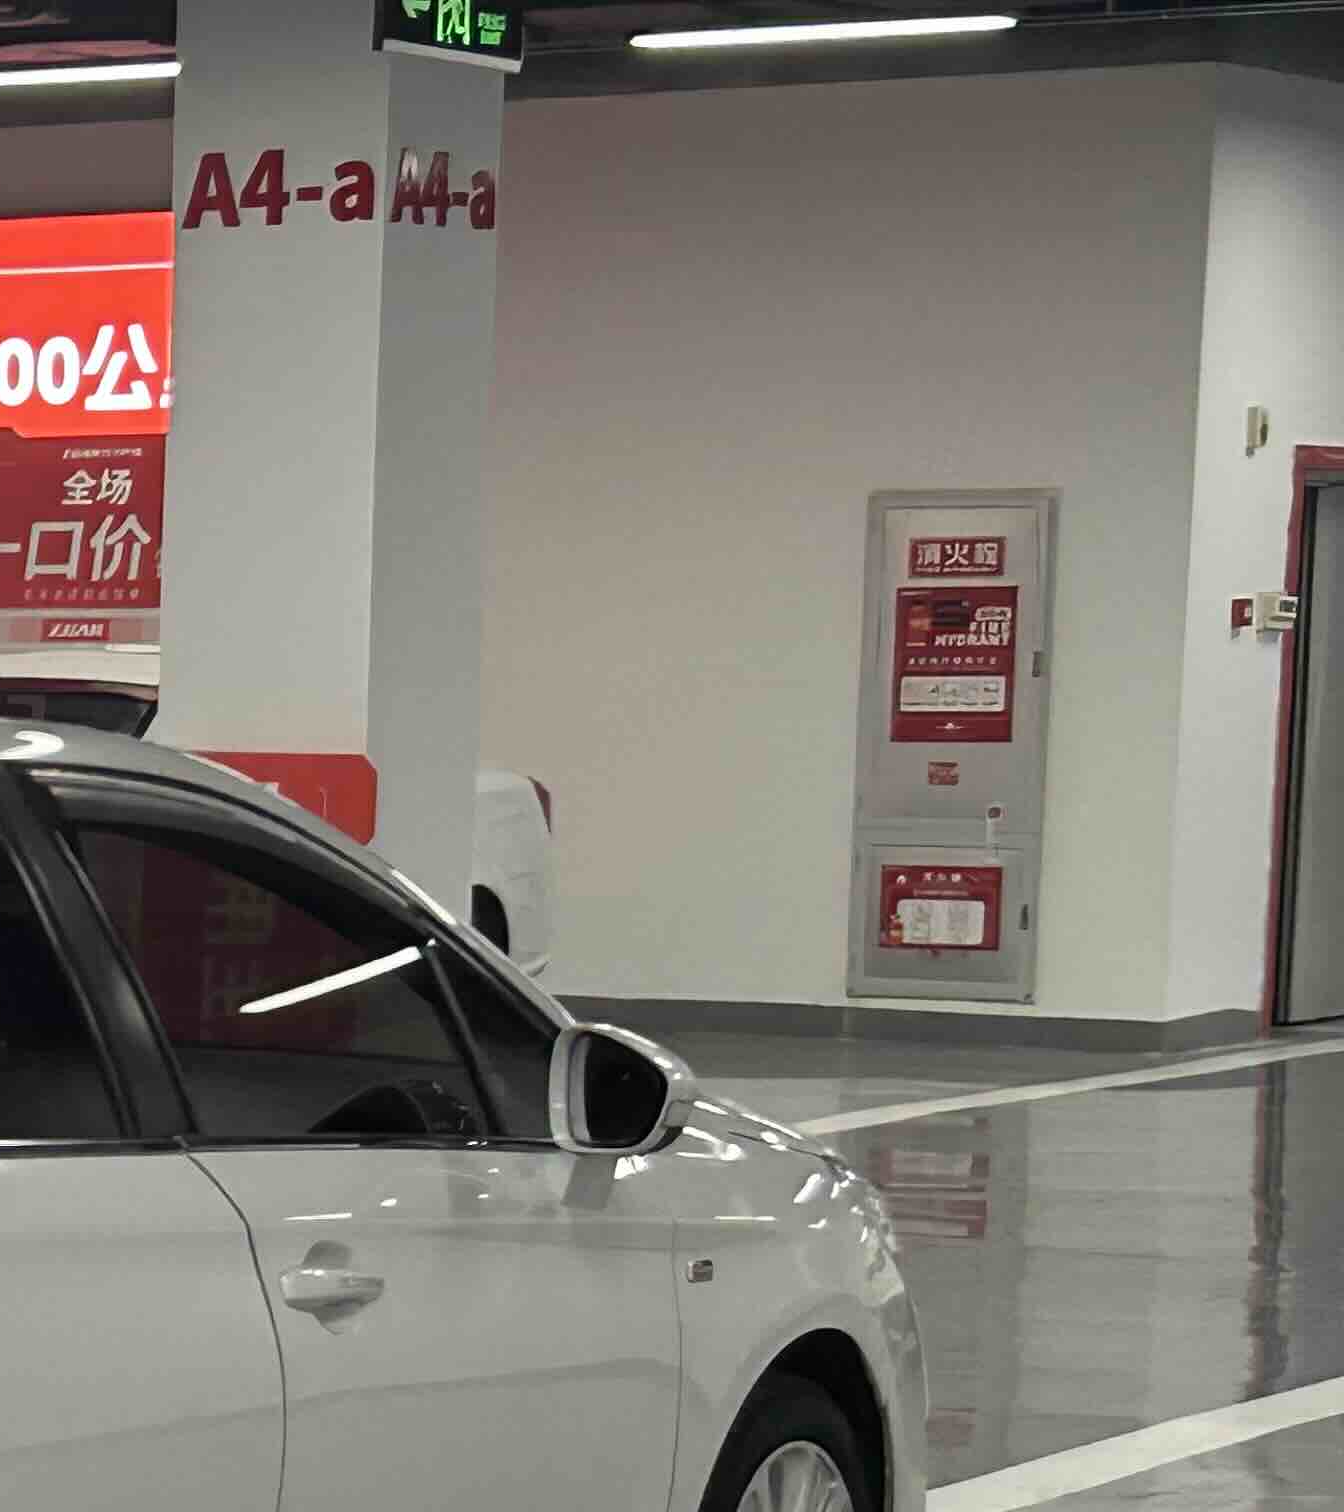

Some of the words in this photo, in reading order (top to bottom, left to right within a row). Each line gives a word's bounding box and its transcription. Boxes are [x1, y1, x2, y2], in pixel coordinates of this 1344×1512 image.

[182, 149, 375, 229] A4-a
[389, 147, 496, 230] A4-a
[62, 468, 133, 505] 全场
